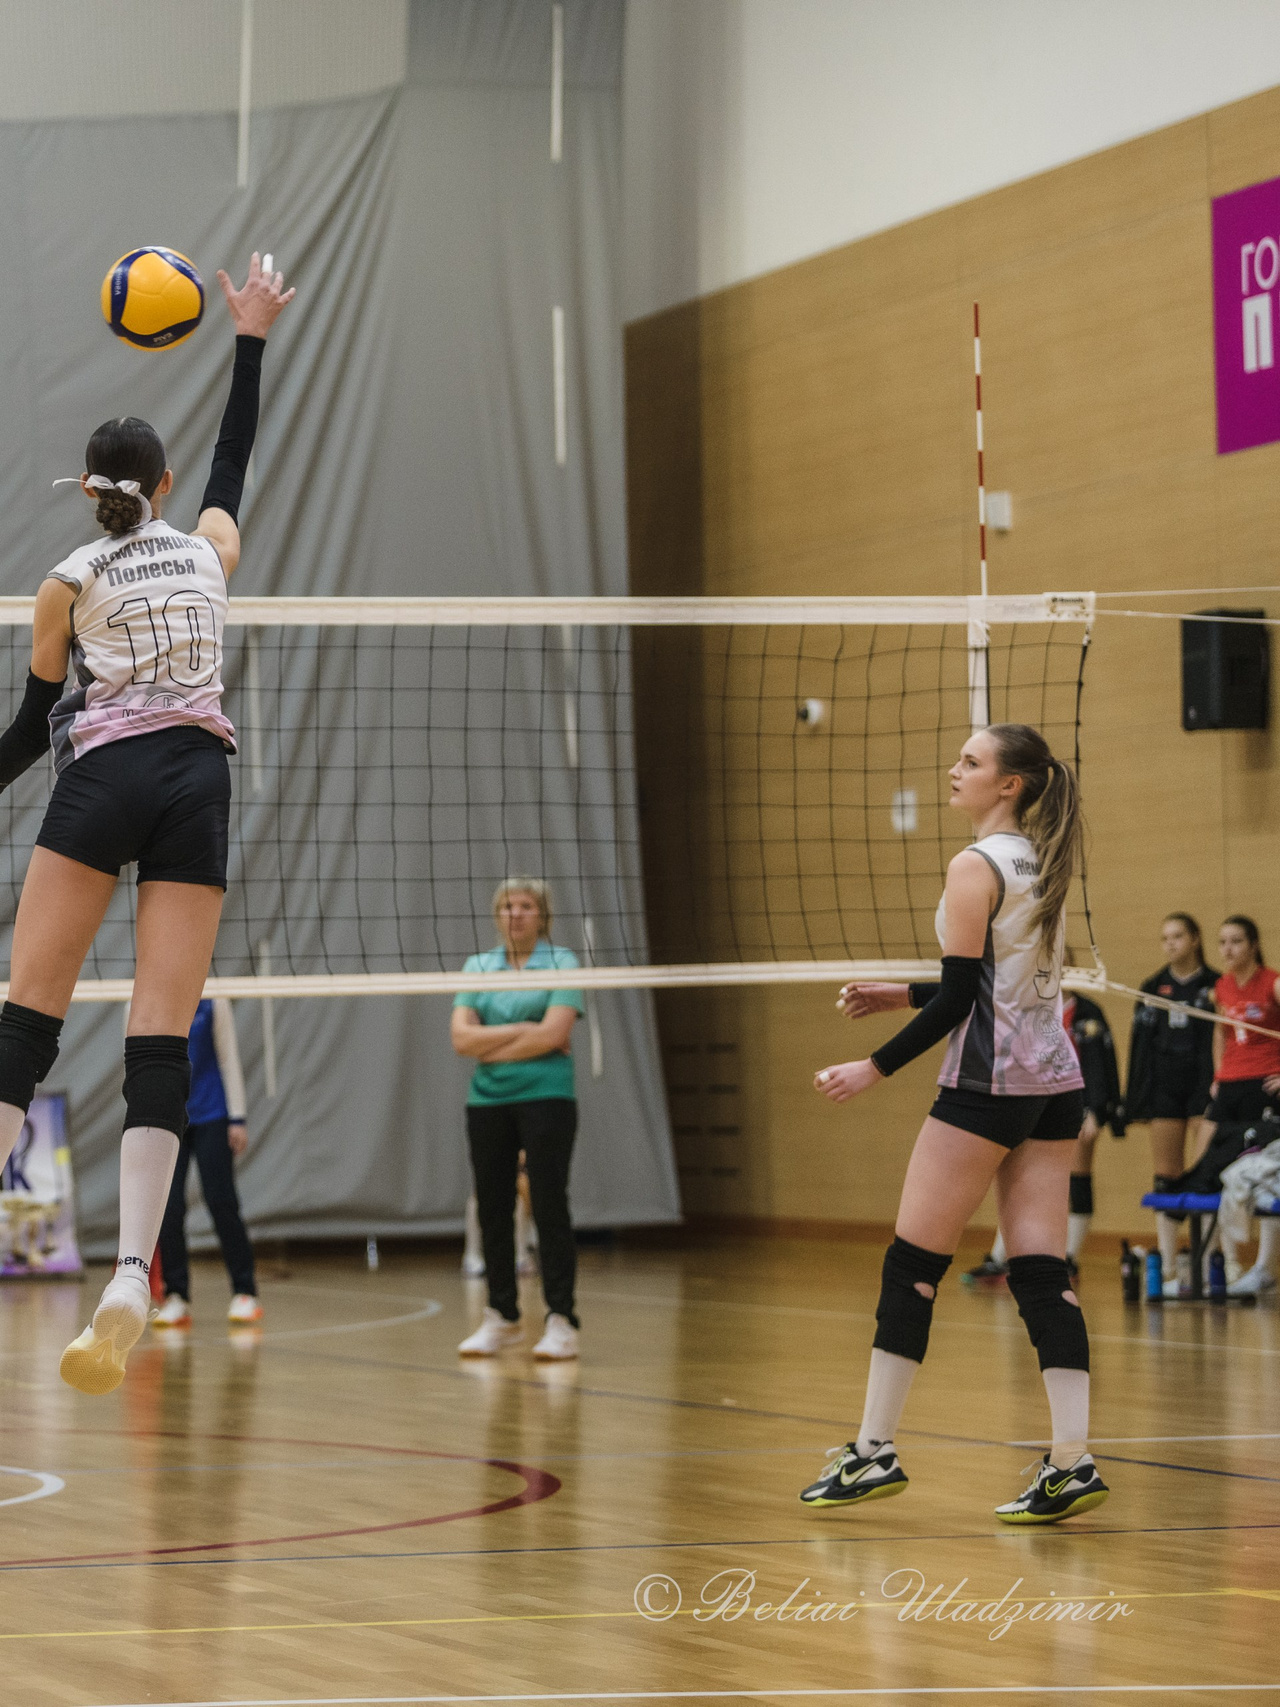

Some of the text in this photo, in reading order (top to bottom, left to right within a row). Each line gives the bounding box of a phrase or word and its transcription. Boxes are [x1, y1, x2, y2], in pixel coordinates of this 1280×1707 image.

[1241, 236, 1280, 296] ГО
[1242, 290, 1280, 374] П
[106, 558, 196, 587] Полесья
[107, 589, 216, 689] 10
[124, 1255, 150, 1274] erre
